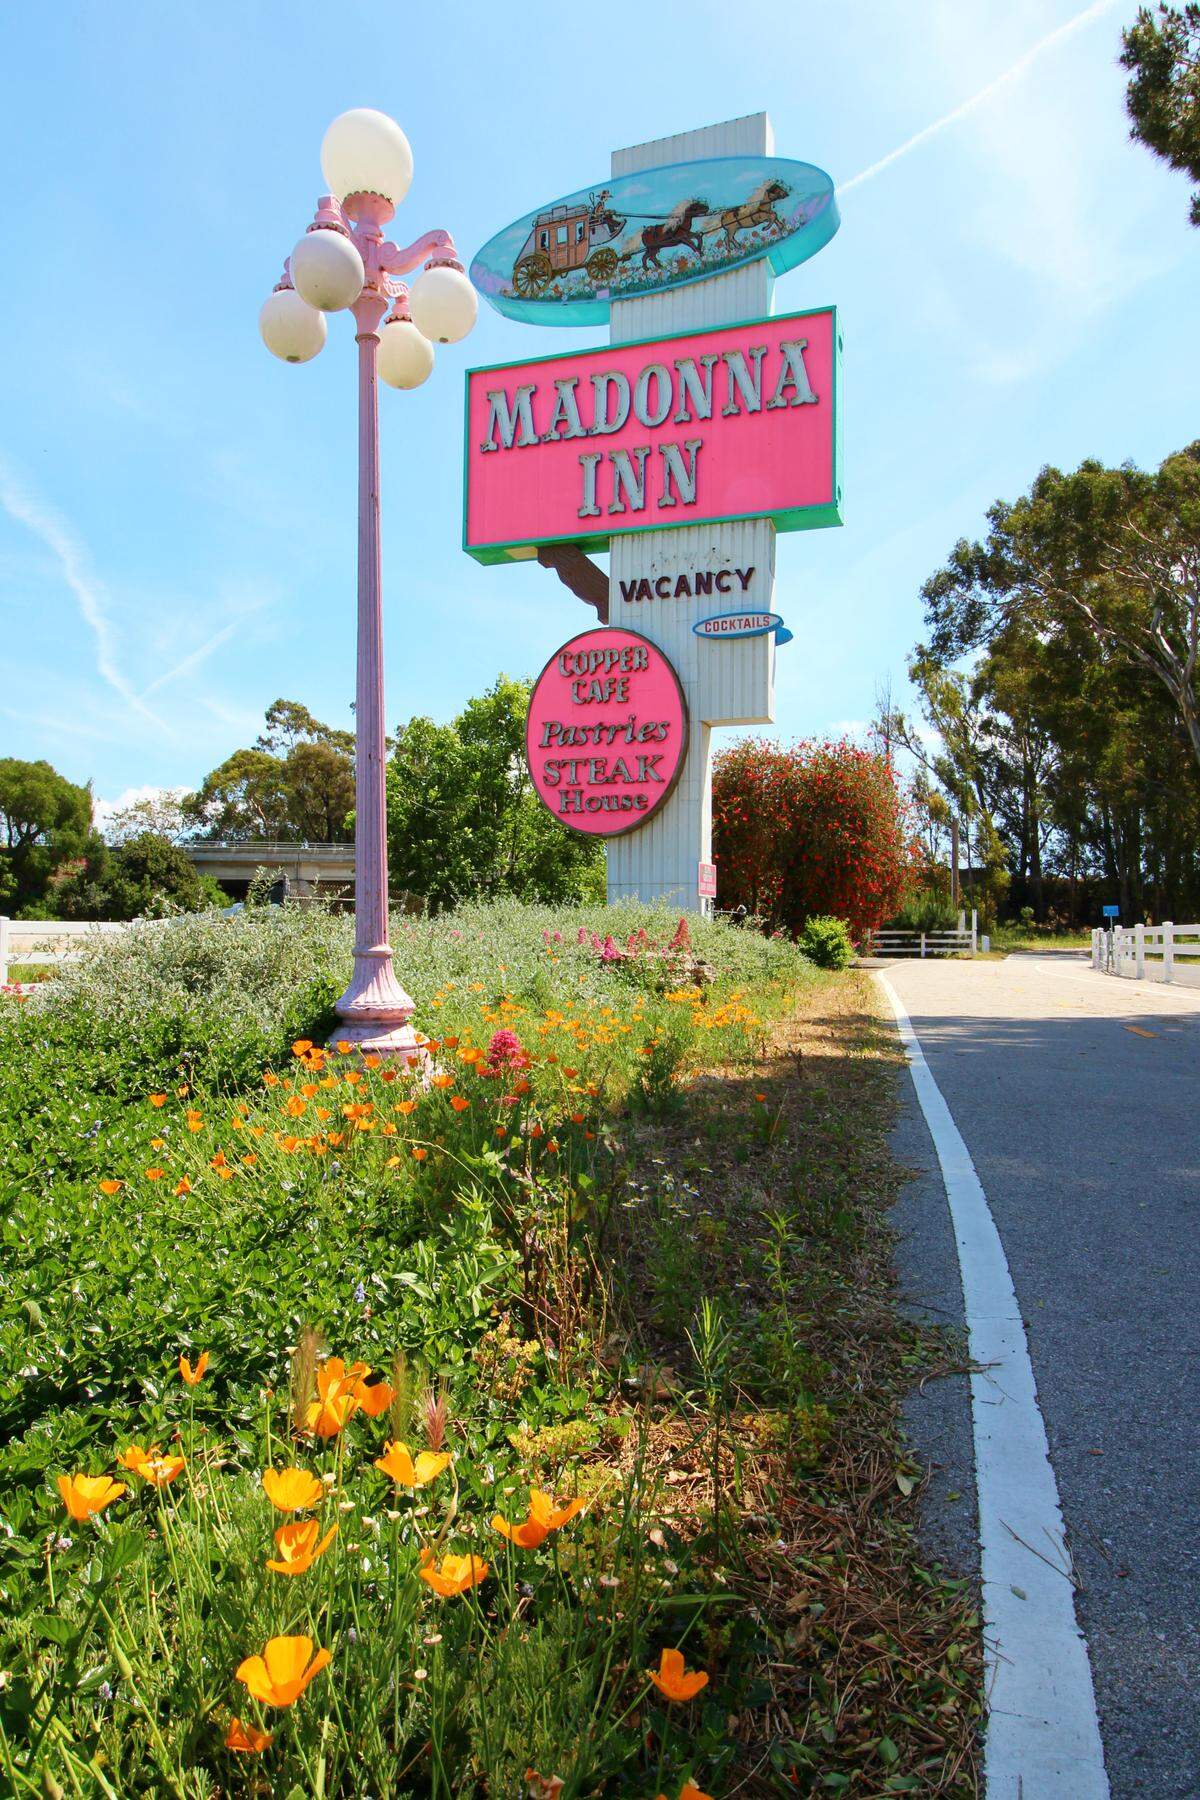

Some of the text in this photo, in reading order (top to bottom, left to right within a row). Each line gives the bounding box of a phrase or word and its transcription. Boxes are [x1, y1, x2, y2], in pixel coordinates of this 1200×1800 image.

[480, 338, 819, 453] MADONNA
[578, 439, 702, 518] INN
[619, 567, 756, 602] VACANCY
[704, 615, 770, 633] COCKTAILS
[557, 646, 650, 677] COPPER
[571, 677, 631, 705] CAFE
[538, 714, 671, 749] Pastries
[543, 754, 665, 786] STEAK
[558, 789, 649, 814] House
